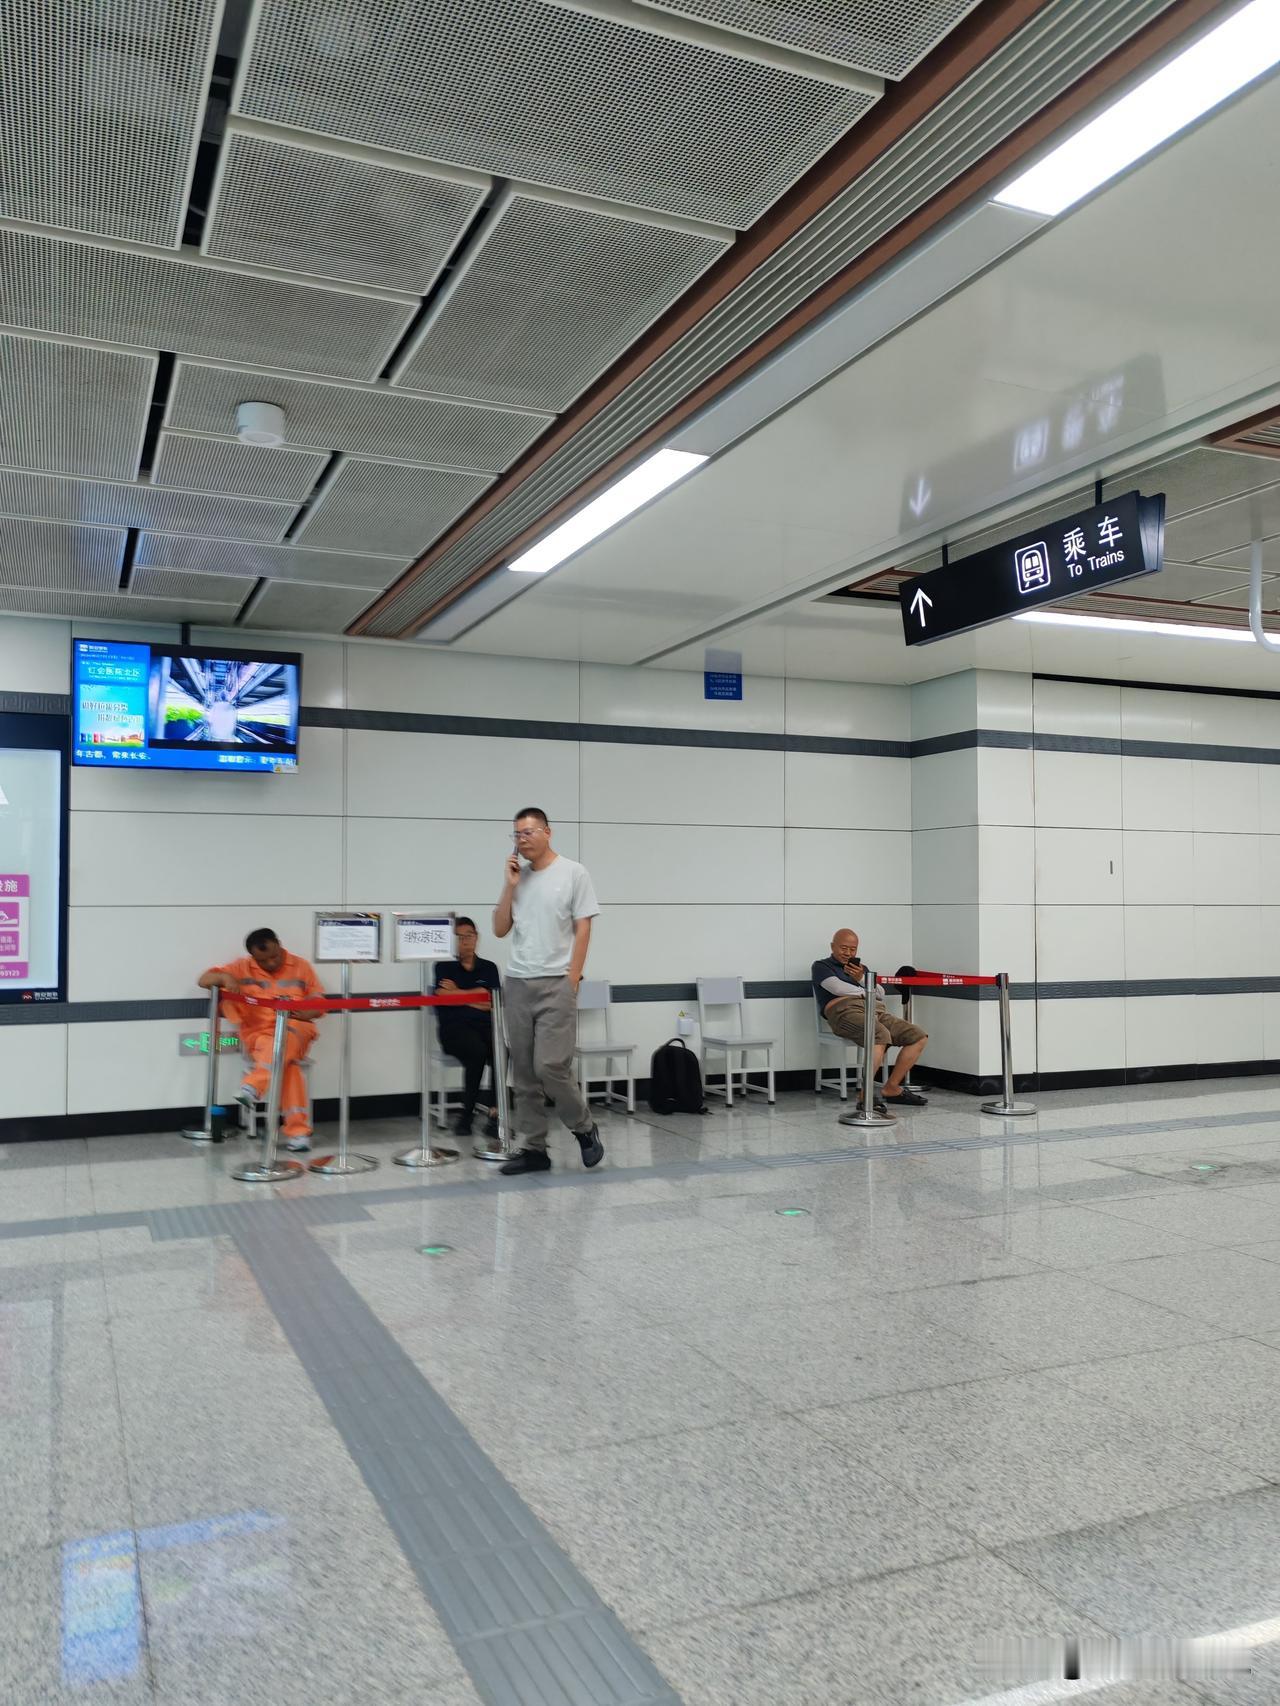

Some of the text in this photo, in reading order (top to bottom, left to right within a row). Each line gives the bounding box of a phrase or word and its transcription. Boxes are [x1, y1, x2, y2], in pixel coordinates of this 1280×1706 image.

[1062, 515, 1123, 562] 乘车
[1067, 548, 1124, 578] To Trains
[0, 879, 18, 893] 施
